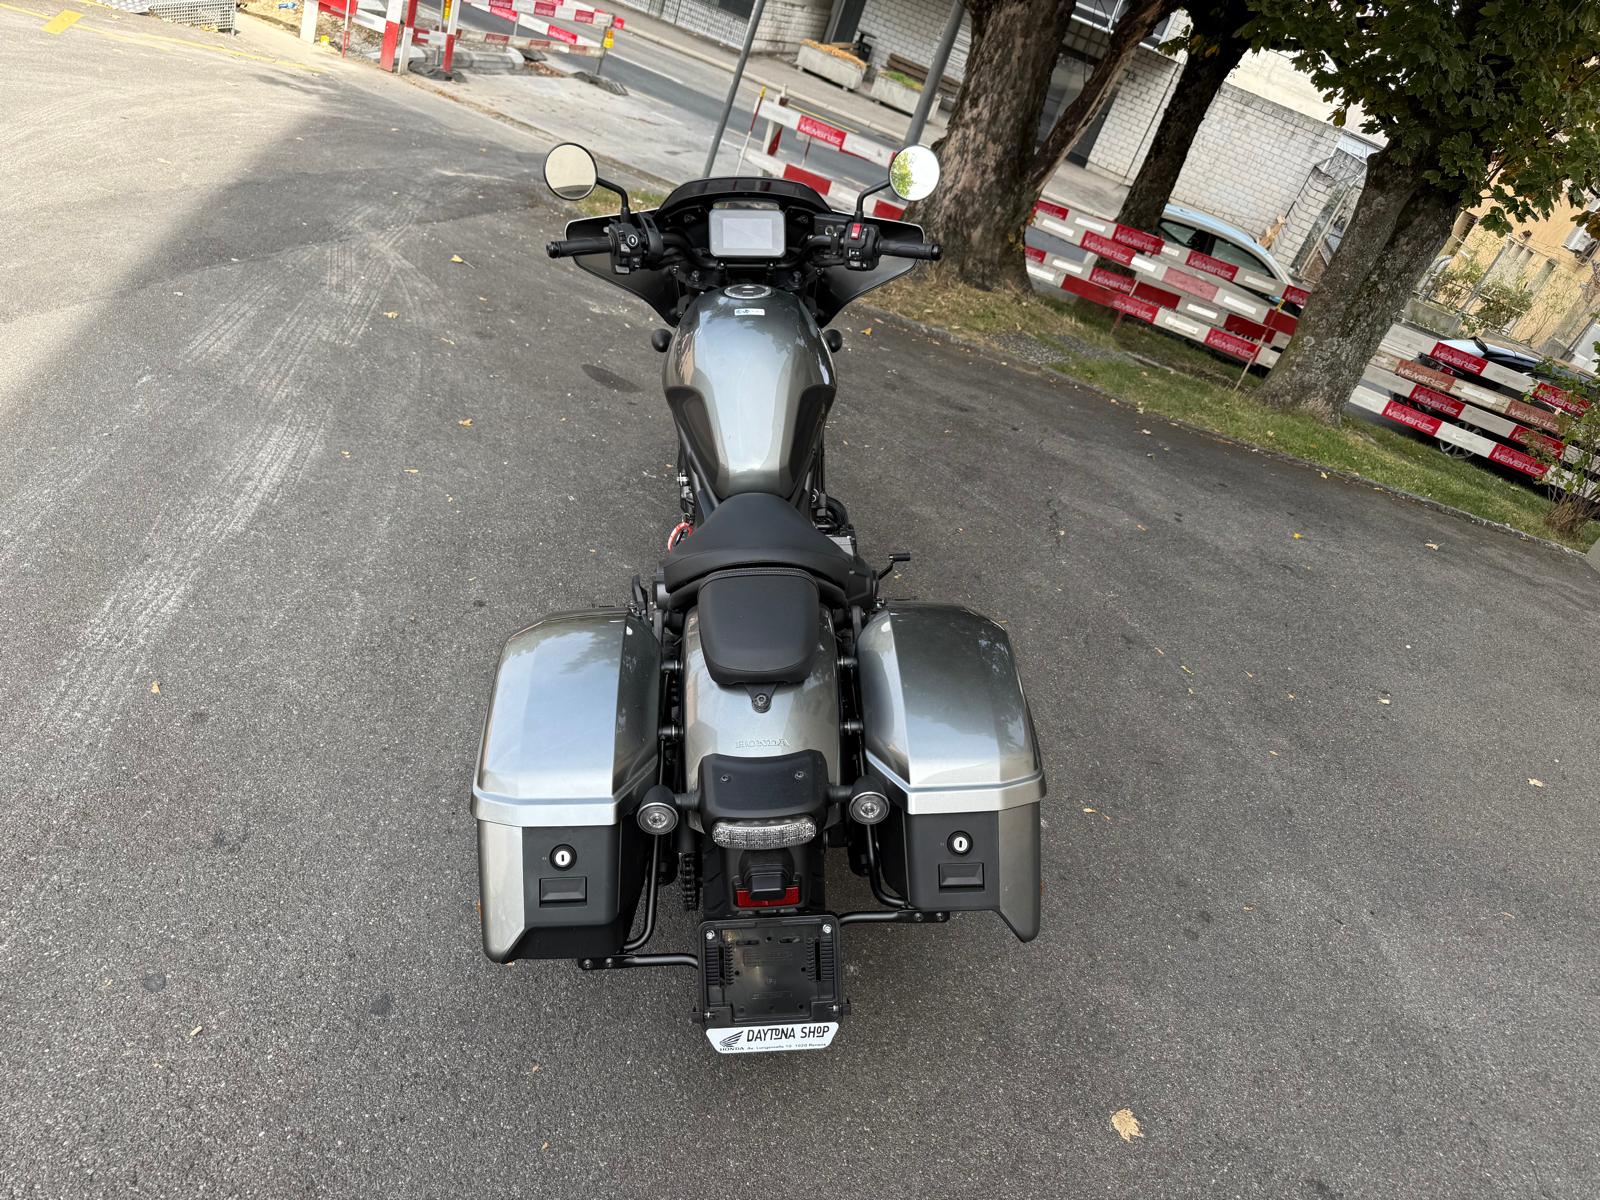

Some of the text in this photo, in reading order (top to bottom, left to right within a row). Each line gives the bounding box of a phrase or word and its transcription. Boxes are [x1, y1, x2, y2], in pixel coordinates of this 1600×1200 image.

[1434, 350, 1481, 372] MEMBREZ
[1398, 367, 1448, 389] MEMBREZ
[1412, 392, 1459, 415] MEMBREZ
[1385, 408, 1435, 432] MEMBREZ
[1492, 452, 1543, 475] MEMBREZ
[746, 1025, 830, 1042] DAYTONA SHOP
